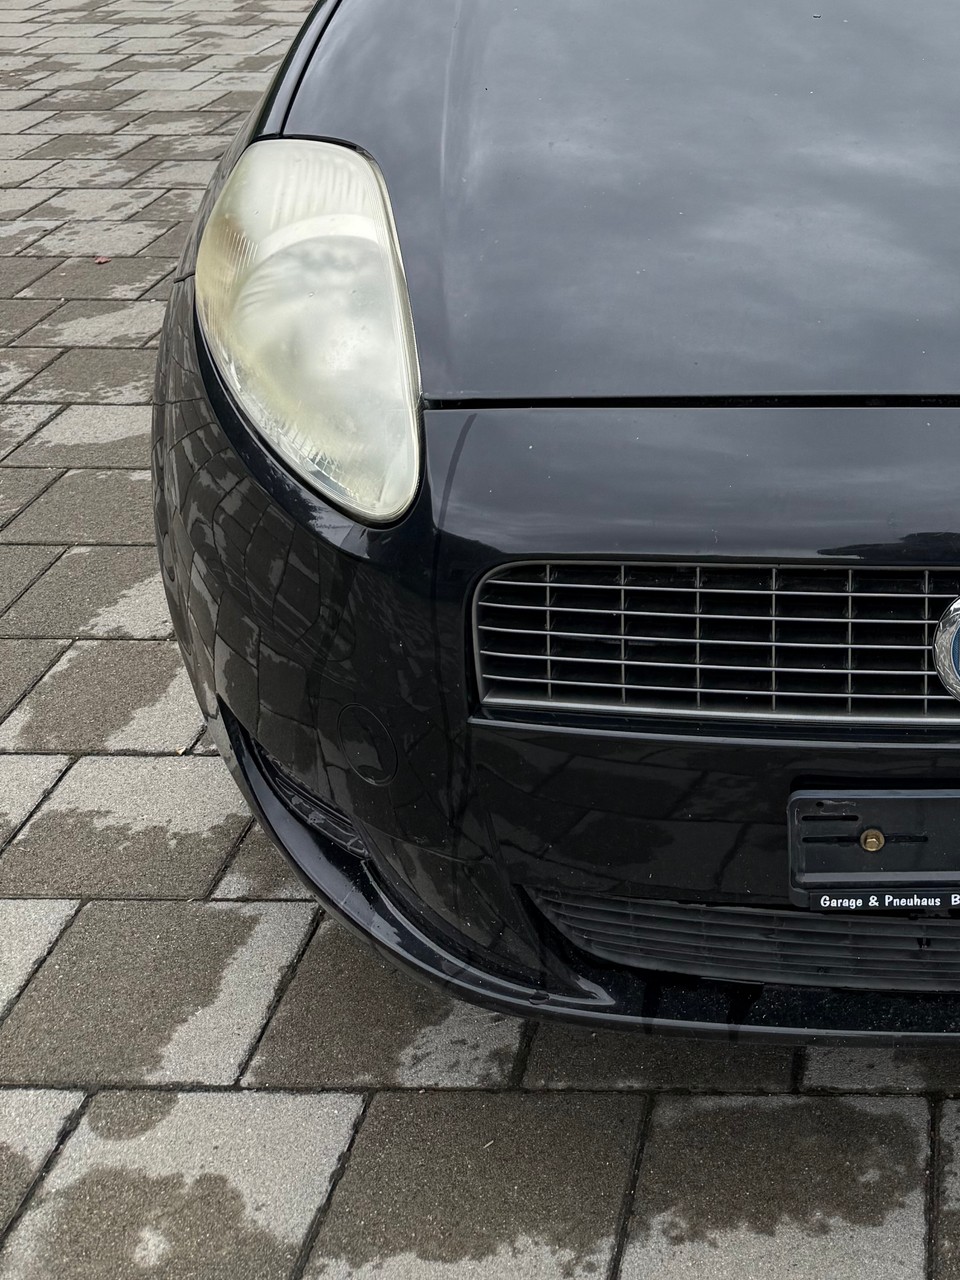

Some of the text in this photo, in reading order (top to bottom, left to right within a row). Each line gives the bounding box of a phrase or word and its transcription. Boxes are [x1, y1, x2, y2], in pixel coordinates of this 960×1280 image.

[820, 895, 863, 910] Garage
[868, 895, 880, 907] &
[884, 894, 941, 907] Pneuhaus
